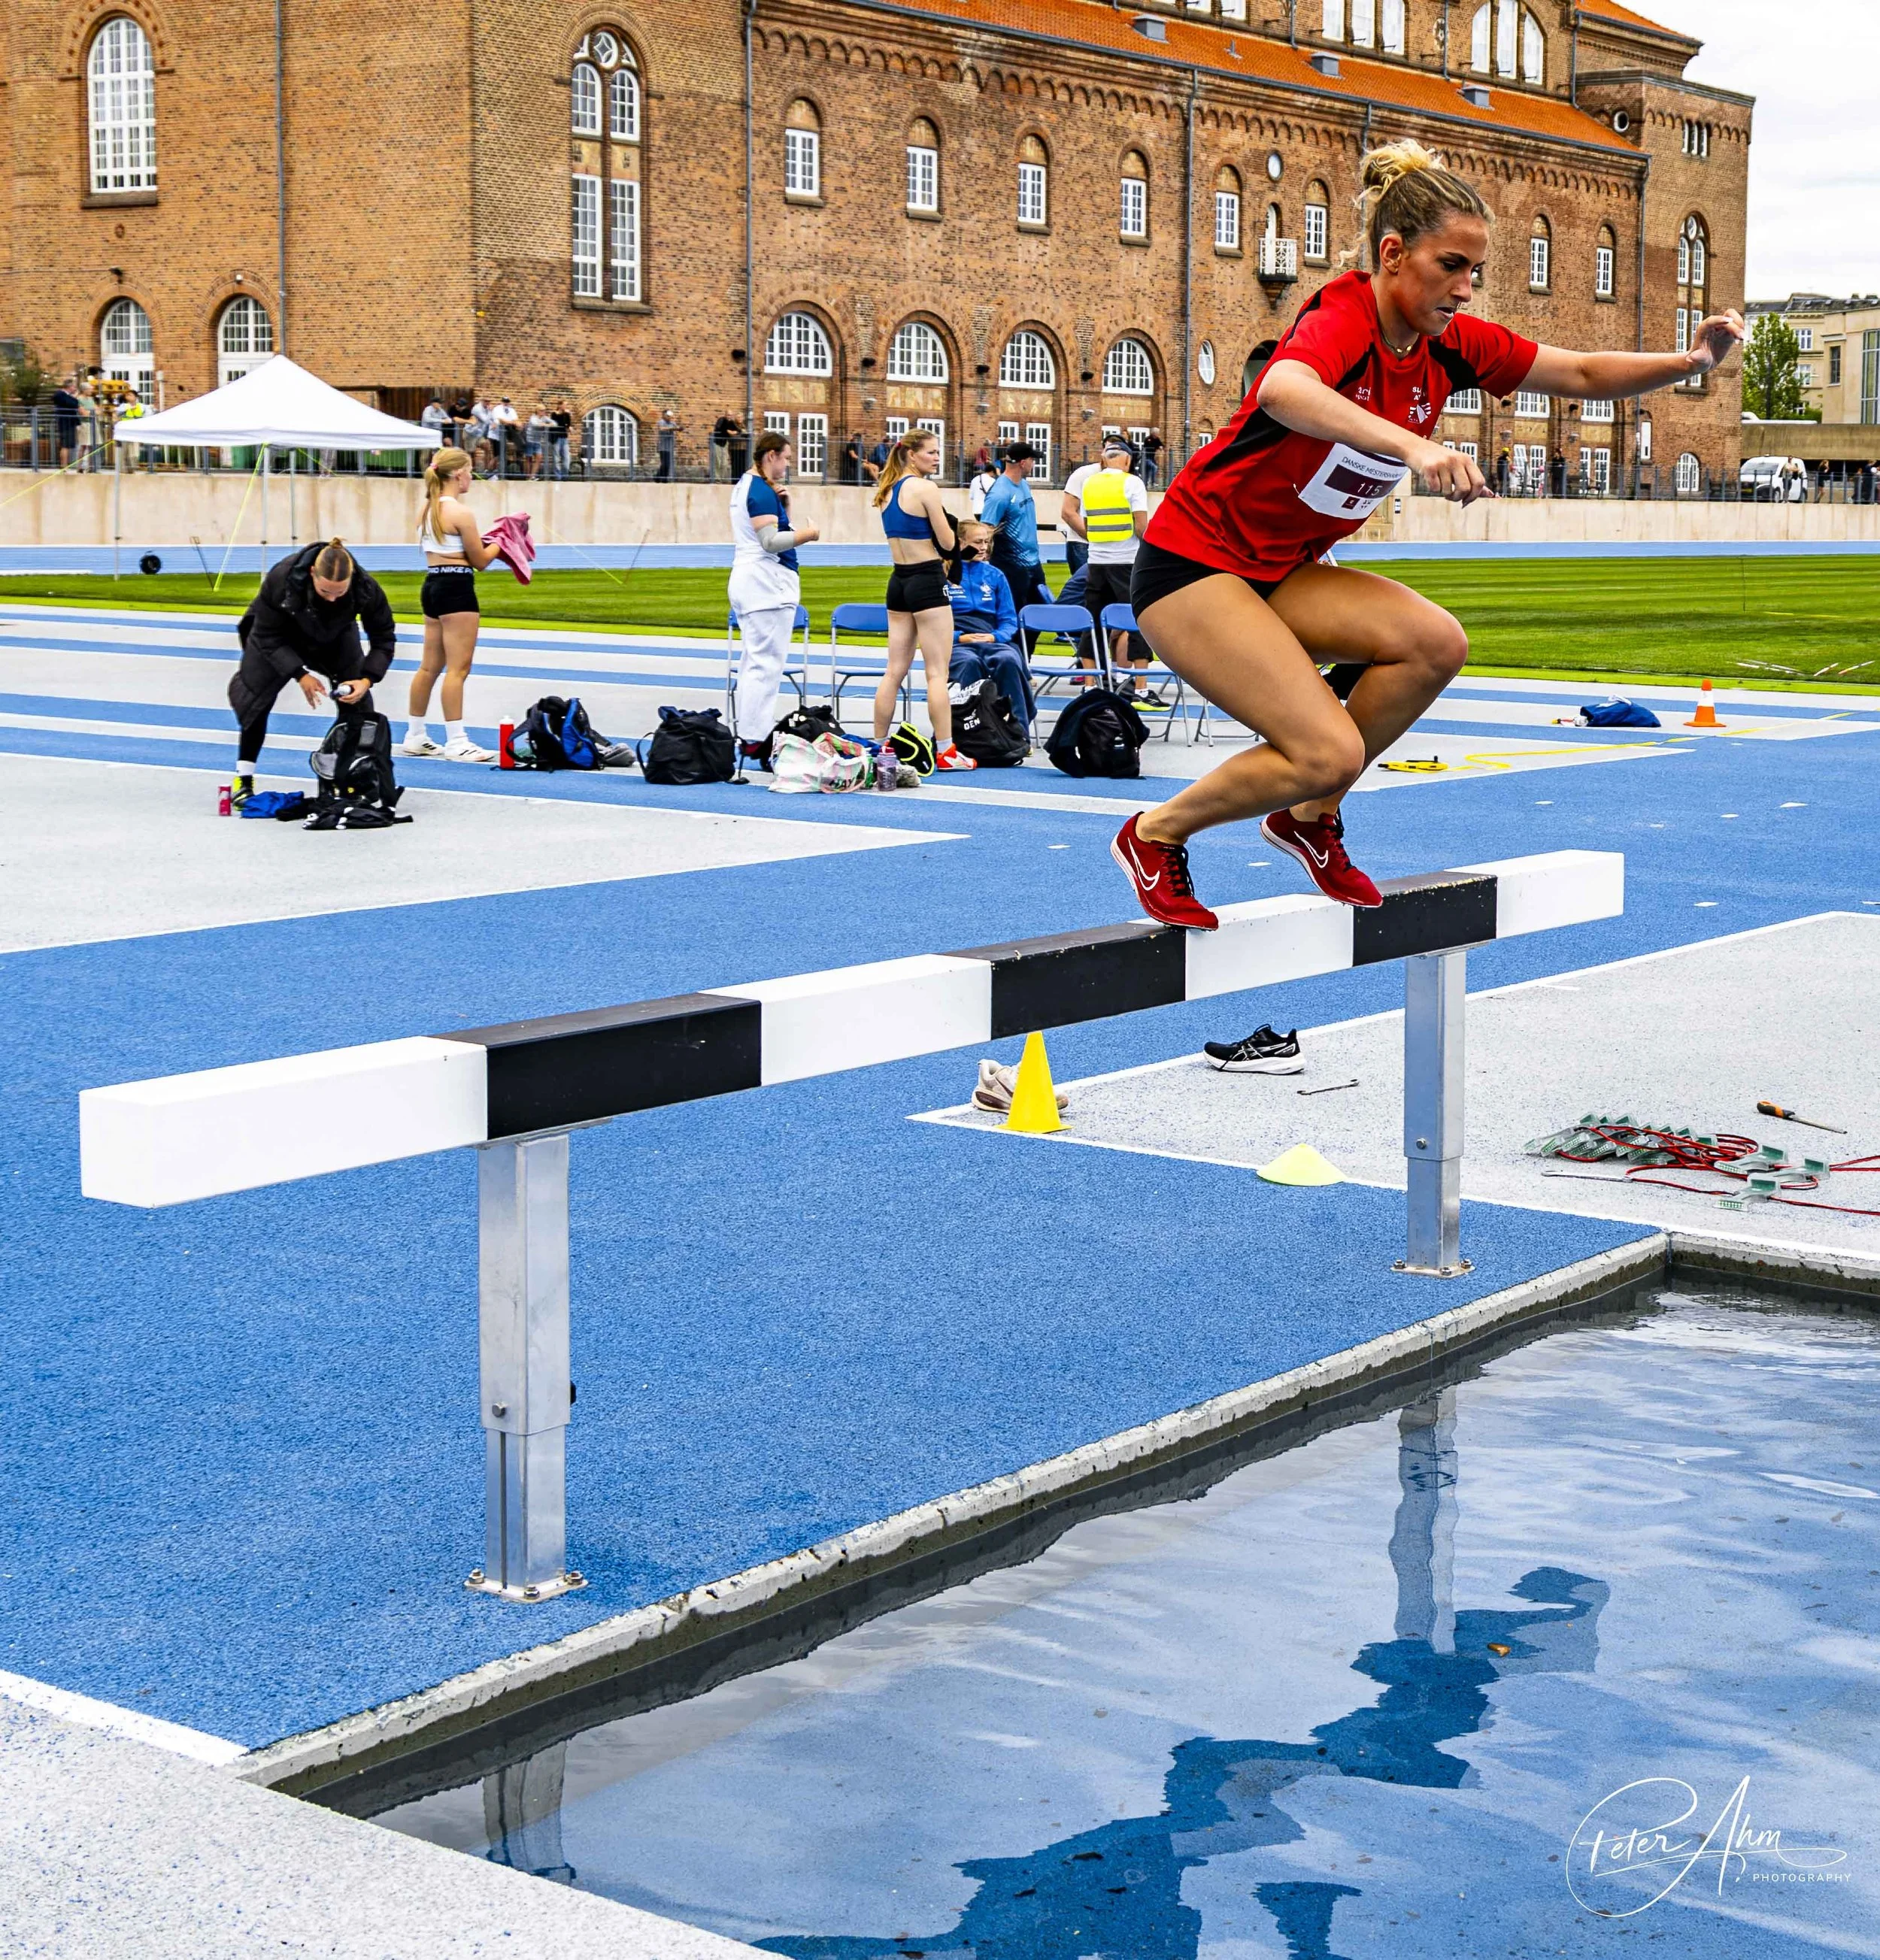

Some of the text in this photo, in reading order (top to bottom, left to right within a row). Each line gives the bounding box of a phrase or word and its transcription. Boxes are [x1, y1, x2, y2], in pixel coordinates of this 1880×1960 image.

[1342, 456, 1366, 471] DANSKE
[1357, 482, 1383, 496] 115
[963, 718, 981, 730] DEN
